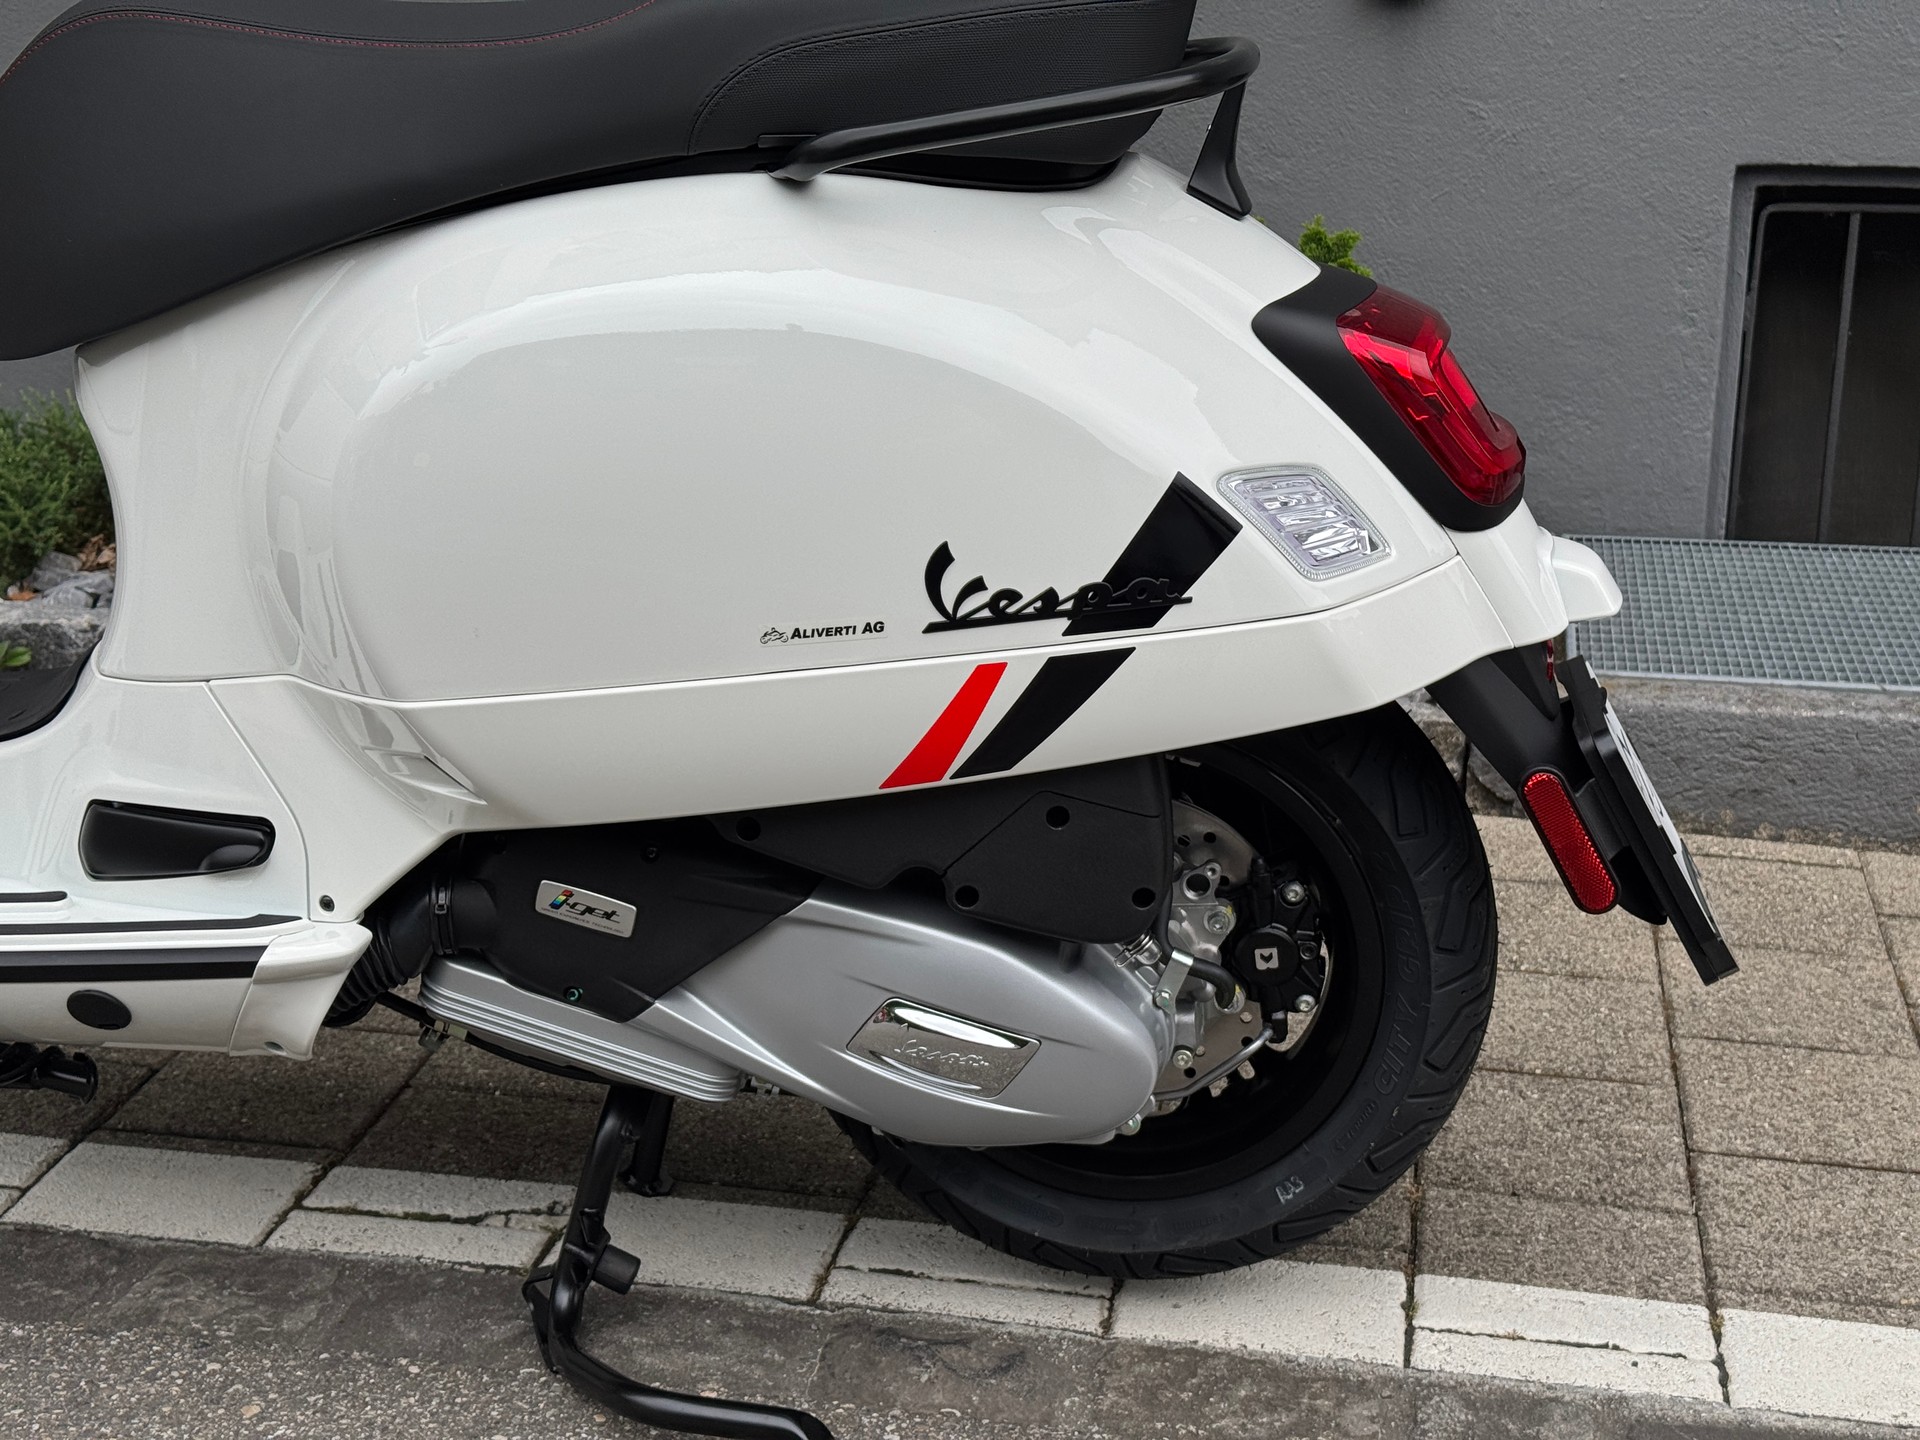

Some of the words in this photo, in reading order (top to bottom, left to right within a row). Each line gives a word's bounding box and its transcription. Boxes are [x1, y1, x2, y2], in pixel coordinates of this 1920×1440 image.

[922, 540, 1193, 634] Vespa
[790, 625, 857, 640] ALIVERTI
[861, 620, 885, 635] AG
[548, 888, 621, 924] i-get
[1374, 992, 1418, 1096] CITY
